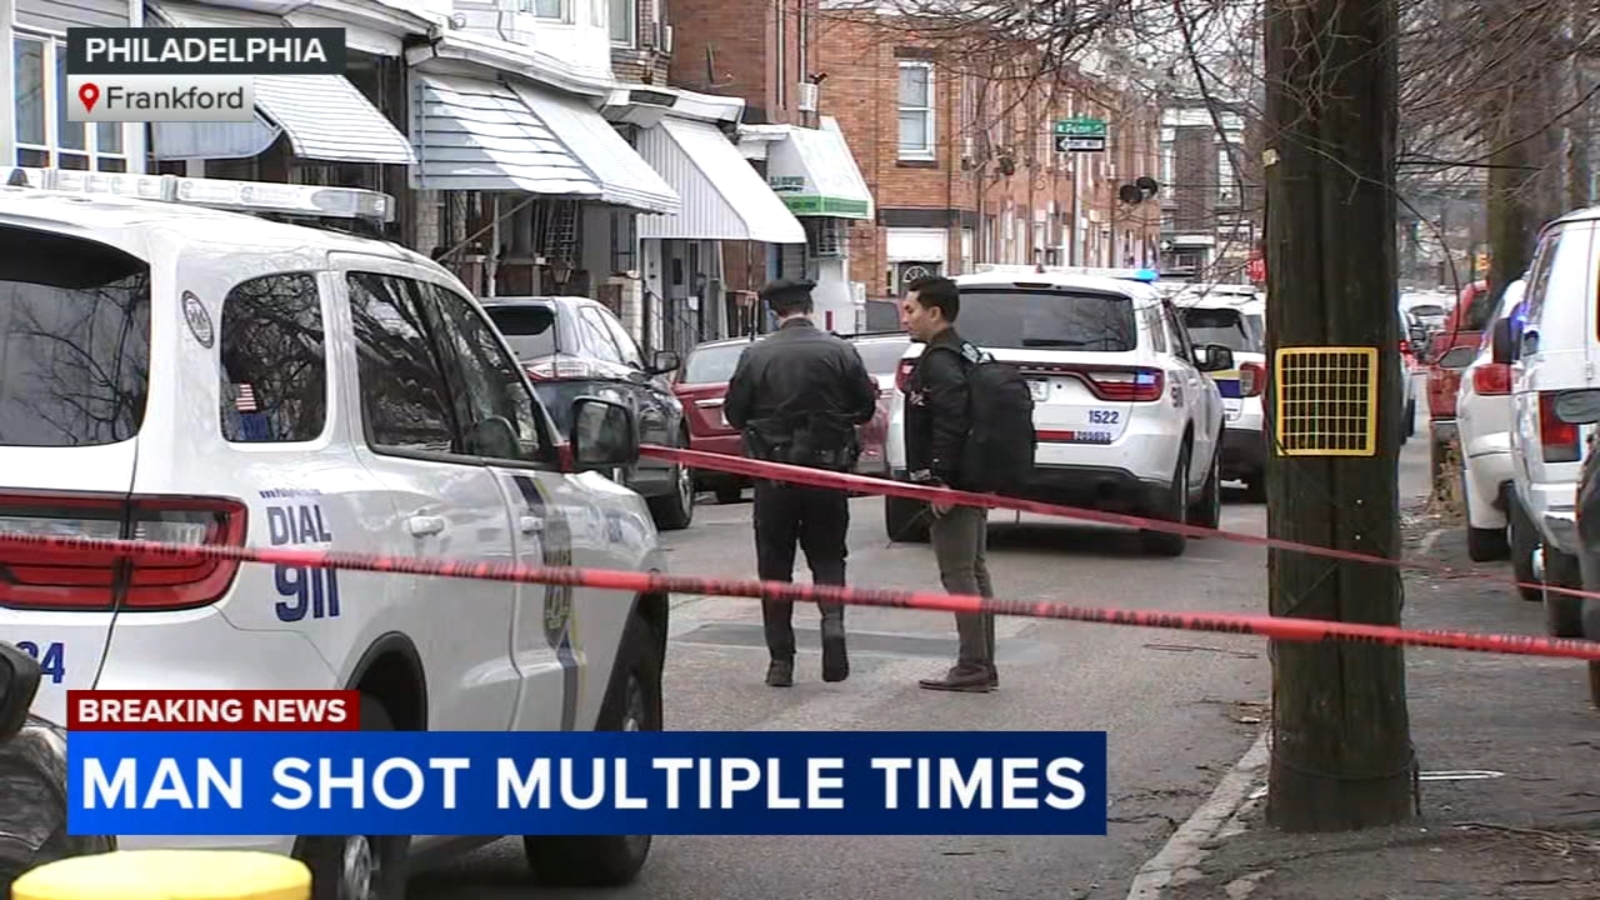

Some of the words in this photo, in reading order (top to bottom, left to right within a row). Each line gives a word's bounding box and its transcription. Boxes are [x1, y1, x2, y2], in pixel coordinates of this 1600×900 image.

[1088, 409, 1119, 425] 1522
[266, 504, 332, 546] DIAL
[274, 563, 340, 622] 911
